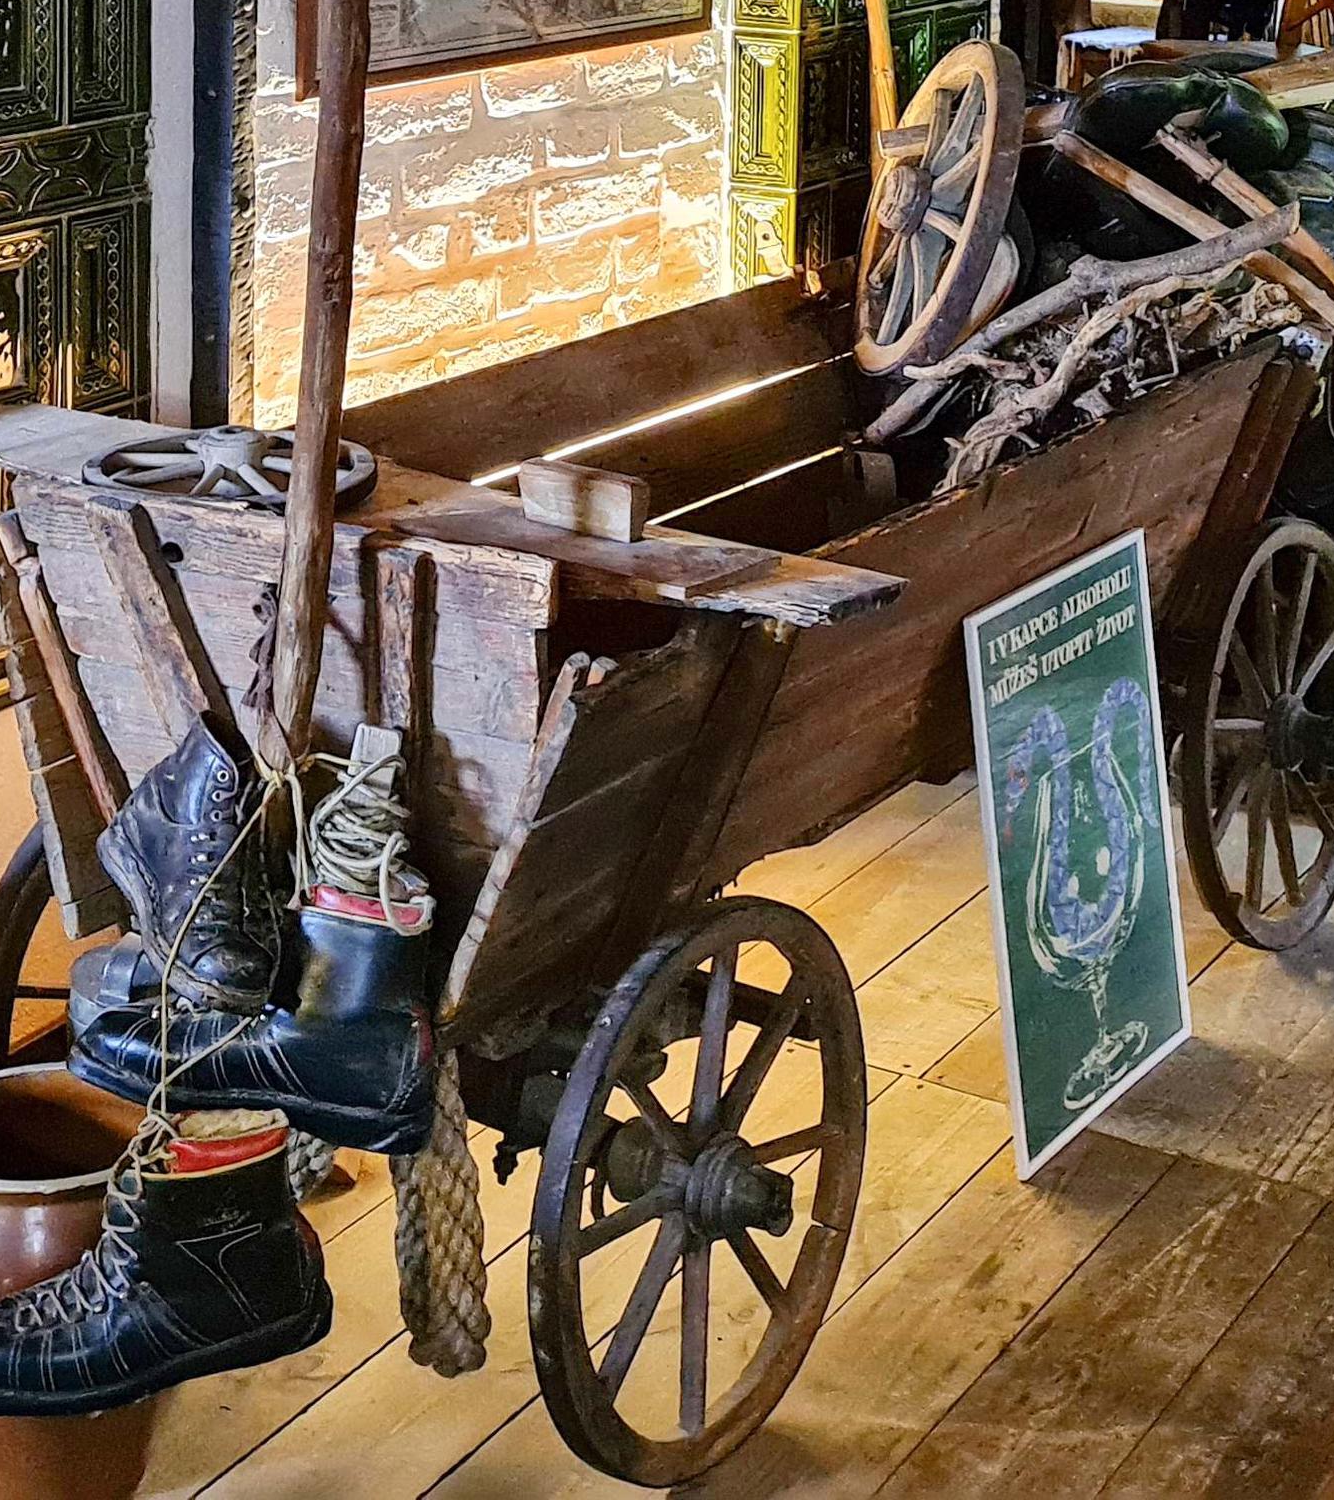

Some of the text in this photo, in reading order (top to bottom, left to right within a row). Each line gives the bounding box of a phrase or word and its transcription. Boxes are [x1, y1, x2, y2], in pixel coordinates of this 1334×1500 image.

[996, 633, 1008, 659] V
[1007, 606, 1059, 653] KAPCE
[1060, 565, 1132, 625] ALKOHOLU
[1040, 628, 1094, 677] UTOPIT
[1096, 604, 1137, 646] ŽIVOT
